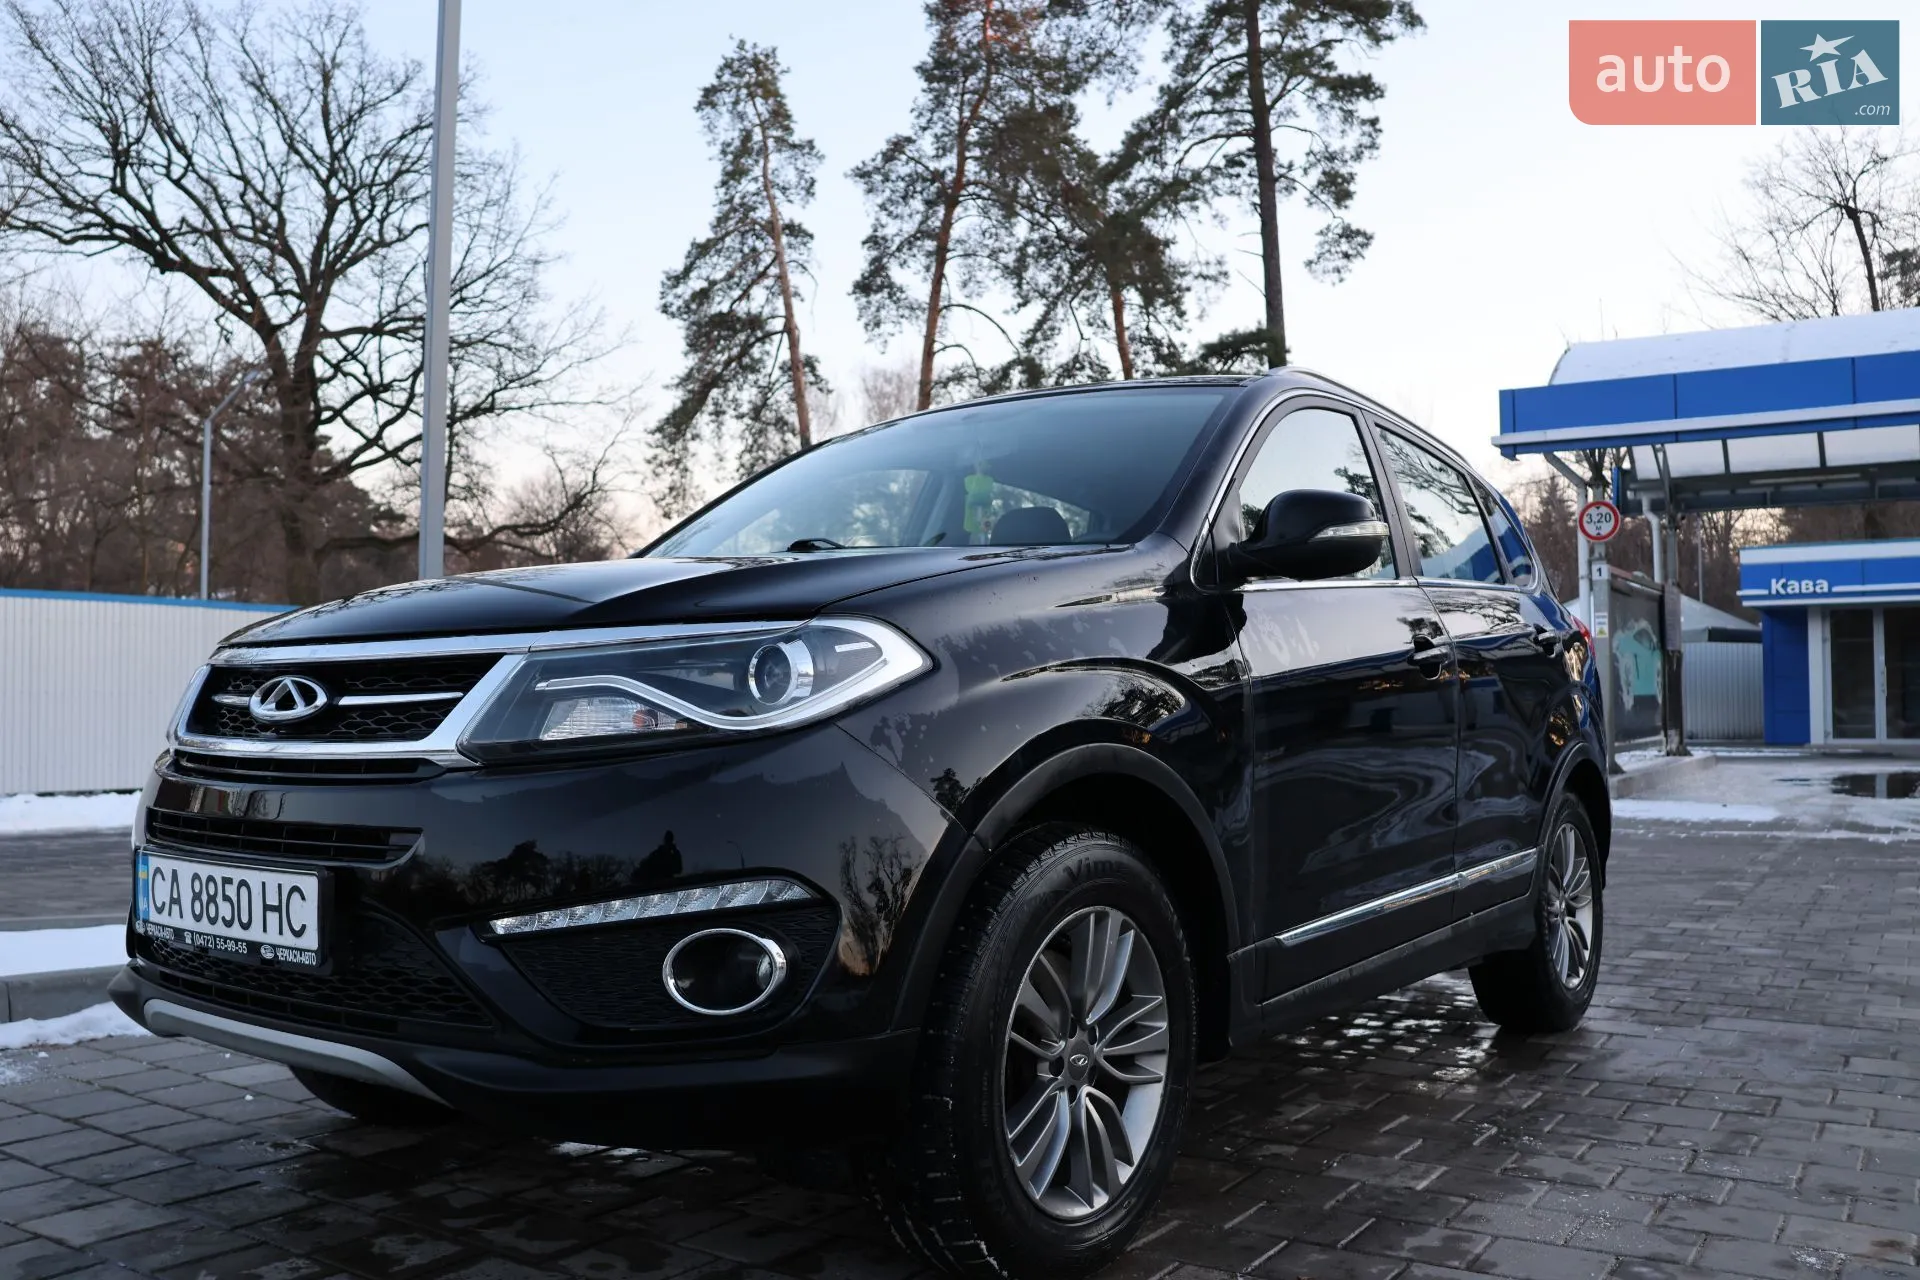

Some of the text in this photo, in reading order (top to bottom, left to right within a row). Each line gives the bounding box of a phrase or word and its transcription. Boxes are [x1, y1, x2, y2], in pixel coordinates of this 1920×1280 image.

[1585, 512, 1612, 525] 3,20
[1771, 578, 1829, 595] Кава
[190, 872, 253, 931] 8850
[193, 935, 248, 954] (0472) 55-99-55
